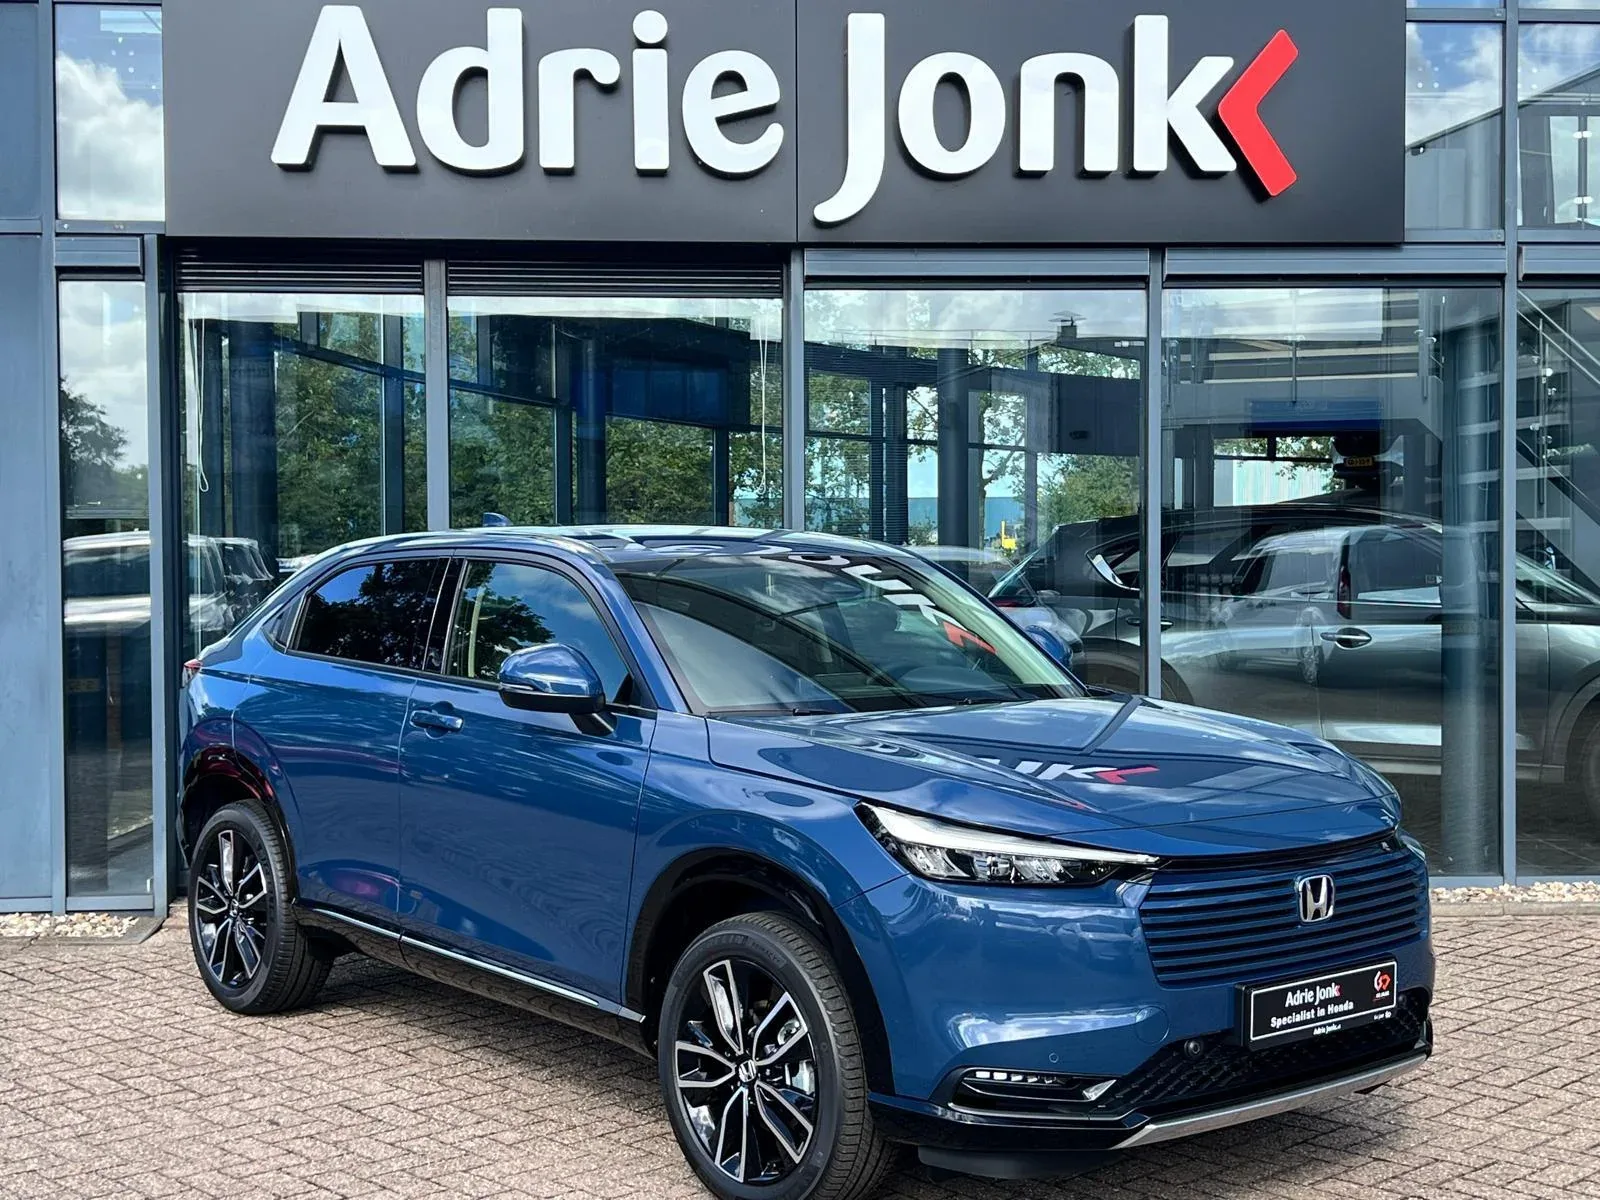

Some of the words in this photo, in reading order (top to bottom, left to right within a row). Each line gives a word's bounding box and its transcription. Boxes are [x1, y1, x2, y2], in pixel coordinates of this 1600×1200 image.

[271, 5, 785, 178] Adrie
[812, 13, 1237, 224] Jonk
[1285, 988, 1314, 1007] Adrie
[1315, 983, 1339, 1005] Jonk
[1270, 1009, 1315, 1029] Specialist
[1317, 1007, 1325, 1017] in
[1327, 1001, 1354, 1015] Honda
